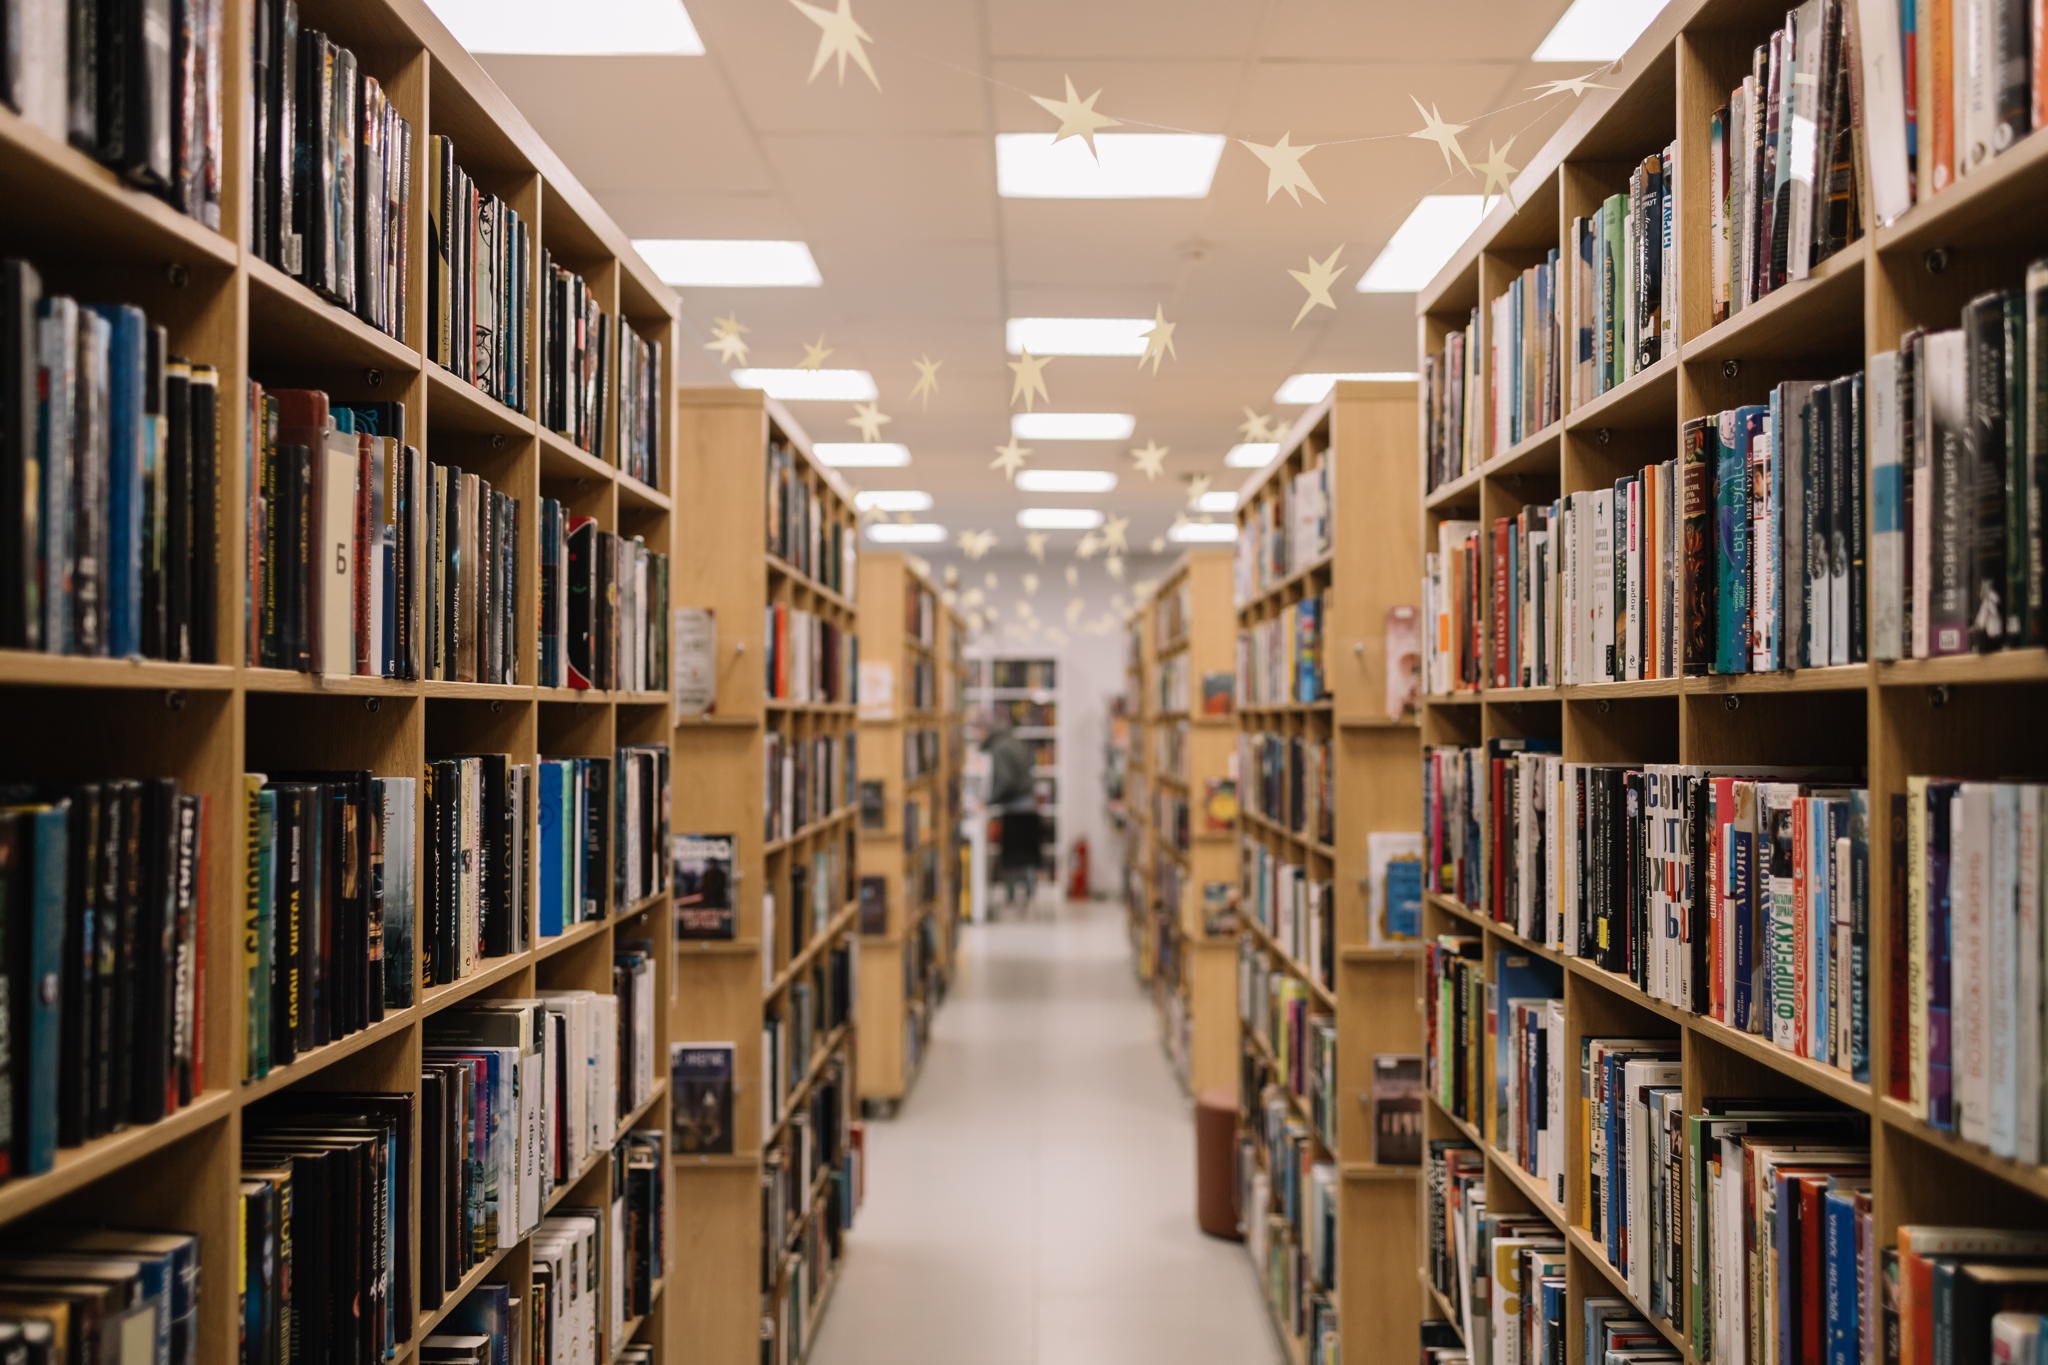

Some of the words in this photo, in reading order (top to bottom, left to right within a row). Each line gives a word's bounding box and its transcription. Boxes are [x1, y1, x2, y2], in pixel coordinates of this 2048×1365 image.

[1663, 195, 1672, 249] СТРАУТ
[1732, 456, 1745, 515] ЧУДЕС
[1942, 431, 1956, 519] АКУШЕРКУ
[335, 542, 348, 575] Б
[1733, 522, 1744, 552] ВЕК
[1629, 581, 1638, 609] морем
[1943, 524, 1957, 611] ВЫЗОВИТЕ
[1630, 613, 1638, 624] за
[1709, 851, 1718, 881] ТИБОР
[1735, 838, 1747, 909] AMORE
[1760, 838, 1771, 911] AMORE
[1709, 884, 1718, 919] ФИШЕР
[1775, 920, 1794, 1020] ФЛОРЕСКУ
[1672, 1161, 1682, 1247] ПОЛУЖИЗНИ
[1828, 1213, 1838, 1258] ХАННА
[1829, 1263, 1839, 1321] КРИСТИН
